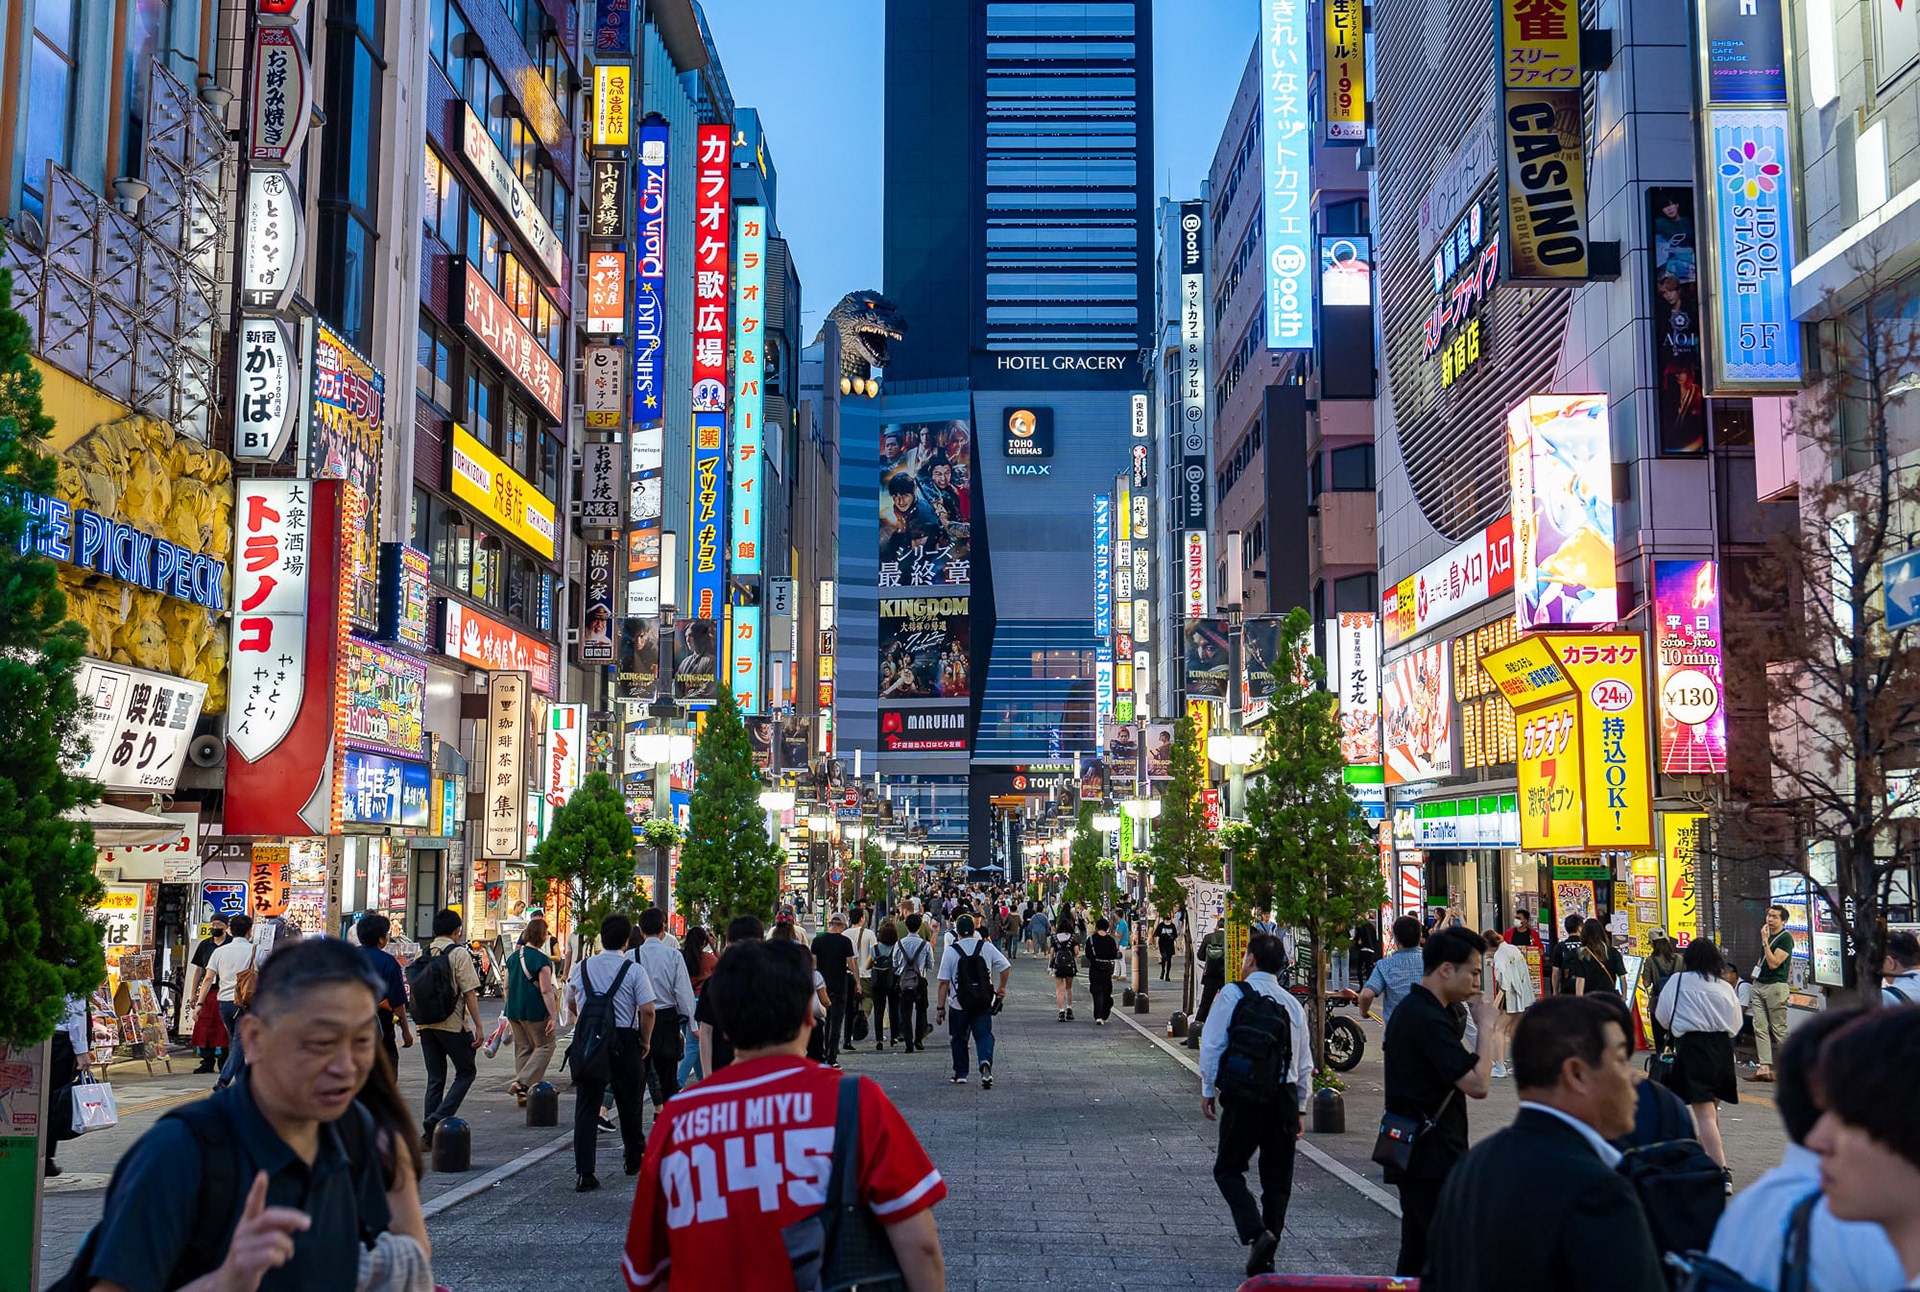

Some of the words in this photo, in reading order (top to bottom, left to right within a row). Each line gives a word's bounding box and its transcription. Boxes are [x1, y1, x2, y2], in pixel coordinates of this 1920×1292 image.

[1333, 0, 1350, 58] 生ビール
[1509, 49, 1559, 64] スリー
[1509, 67, 1576, 83] ファイブ
[264, 49, 287, 145] お好み焼き
[608, 77, 624, 134] 鳥貴族
[1338, 62, 1351, 116] 199円
[1270, 0, 1303, 234] きれいなネットカフェ
[254, 147, 282, 158] 2階
[471, 122, 486, 165] 3F
[597, 163, 620, 227] 山内農場
[1508, 102, 1584, 267] CASINO
[697, 134, 726, 367] カラオケ歌広場
[1182, 214, 1201, 264] Booth
[1734, 206, 1757, 294] STAGE
[1755, 206, 1778, 280] IDOL
[251, 291, 274, 304] 1F
[467, 281, 480, 317] 5F
[606, 268, 621, 305] 焼肉屋
[1272, 245, 1304, 337] Booth
[1188, 280, 1198, 338] ネットカフェ
[246, 331, 276, 343] 新宿
[481, 294, 551, 402] 山内農場
[637, 296, 657, 391] SHINJUKU
[1189, 344, 1197, 353] &
[1442, 320, 1480, 389] 新宿店
[1663, 333, 1696, 346] AOI
[1740, 323, 1780, 350] 5F
[243, 345, 276, 423] かっぱ
[998, 356, 1049, 370] HOTEL
[1053, 356, 1126, 370] GRACERY
[1188, 358, 1199, 398] カプセル
[319, 371, 341, 402] カフェ
[342, 367, 381, 429] キラリ
[737, 220, 760, 559] カラオケ&パーティー館
[245, 433, 268, 447] B1
[594, 413, 613, 424] 3F
[453, 450, 489, 492] TORIKIZOKU
[1006, 465, 1050, 474] IMAX
[1186, 465, 1204, 517] Booth
[493, 473, 523, 528] 鳥貴族
[584, 503, 618, 516] 大阪家
[698, 457, 720, 573] マツモトキヨシ
[284, 485, 307, 577] 大衆酒場
[527, 506, 553, 540] TORIKIZOKU
[82, 509, 153, 589] PICK
[157, 540, 225, 611] PECK
[878, 560, 971, 588] 最終章
[896, 543, 955, 562] シリーズ
[1190, 544, 1201, 590] カラオケ
[1490, 535, 1511, 578] 入口
[238, 496, 281, 653] トラノコ
[590, 550, 609, 600] 海の家
[879, 597, 969, 617] KINGDOM
[1666, 615, 1710, 631] 平日
[447, 613, 459, 645] 4F
[620, 672, 655, 681] KINGDOM
[736, 623, 754, 709] カラオ
[1189, 670, 1227, 679] KINGDOM
[1562, 646, 1638, 665] カラオケ
[268, 654, 293, 719] やきとり
[677, 673, 714, 682] KINGDOM
[1351, 669, 1367, 704] 九十九
[1598, 686, 1628, 704] 24H
[1666, 687, 1714, 706] ¥130
[238, 666, 268, 735] やきとん
[907, 714, 965, 730] MARUHAN
[497, 717, 514, 787] 珈琲茶館
[1522, 709, 1575, 761] カラオケ
[1602, 717, 1628, 831] 持込OK!
[492, 795, 515, 818] 集
[1528, 786, 1575, 818] 激安セブン
[496, 838, 508, 846] 2F
[253, 864, 273, 911] 立呑み
[672, 1101, 738, 1145] KISHI
[745, 1092, 812, 1129] MIYU
[660, 1126, 836, 1230] 0145
